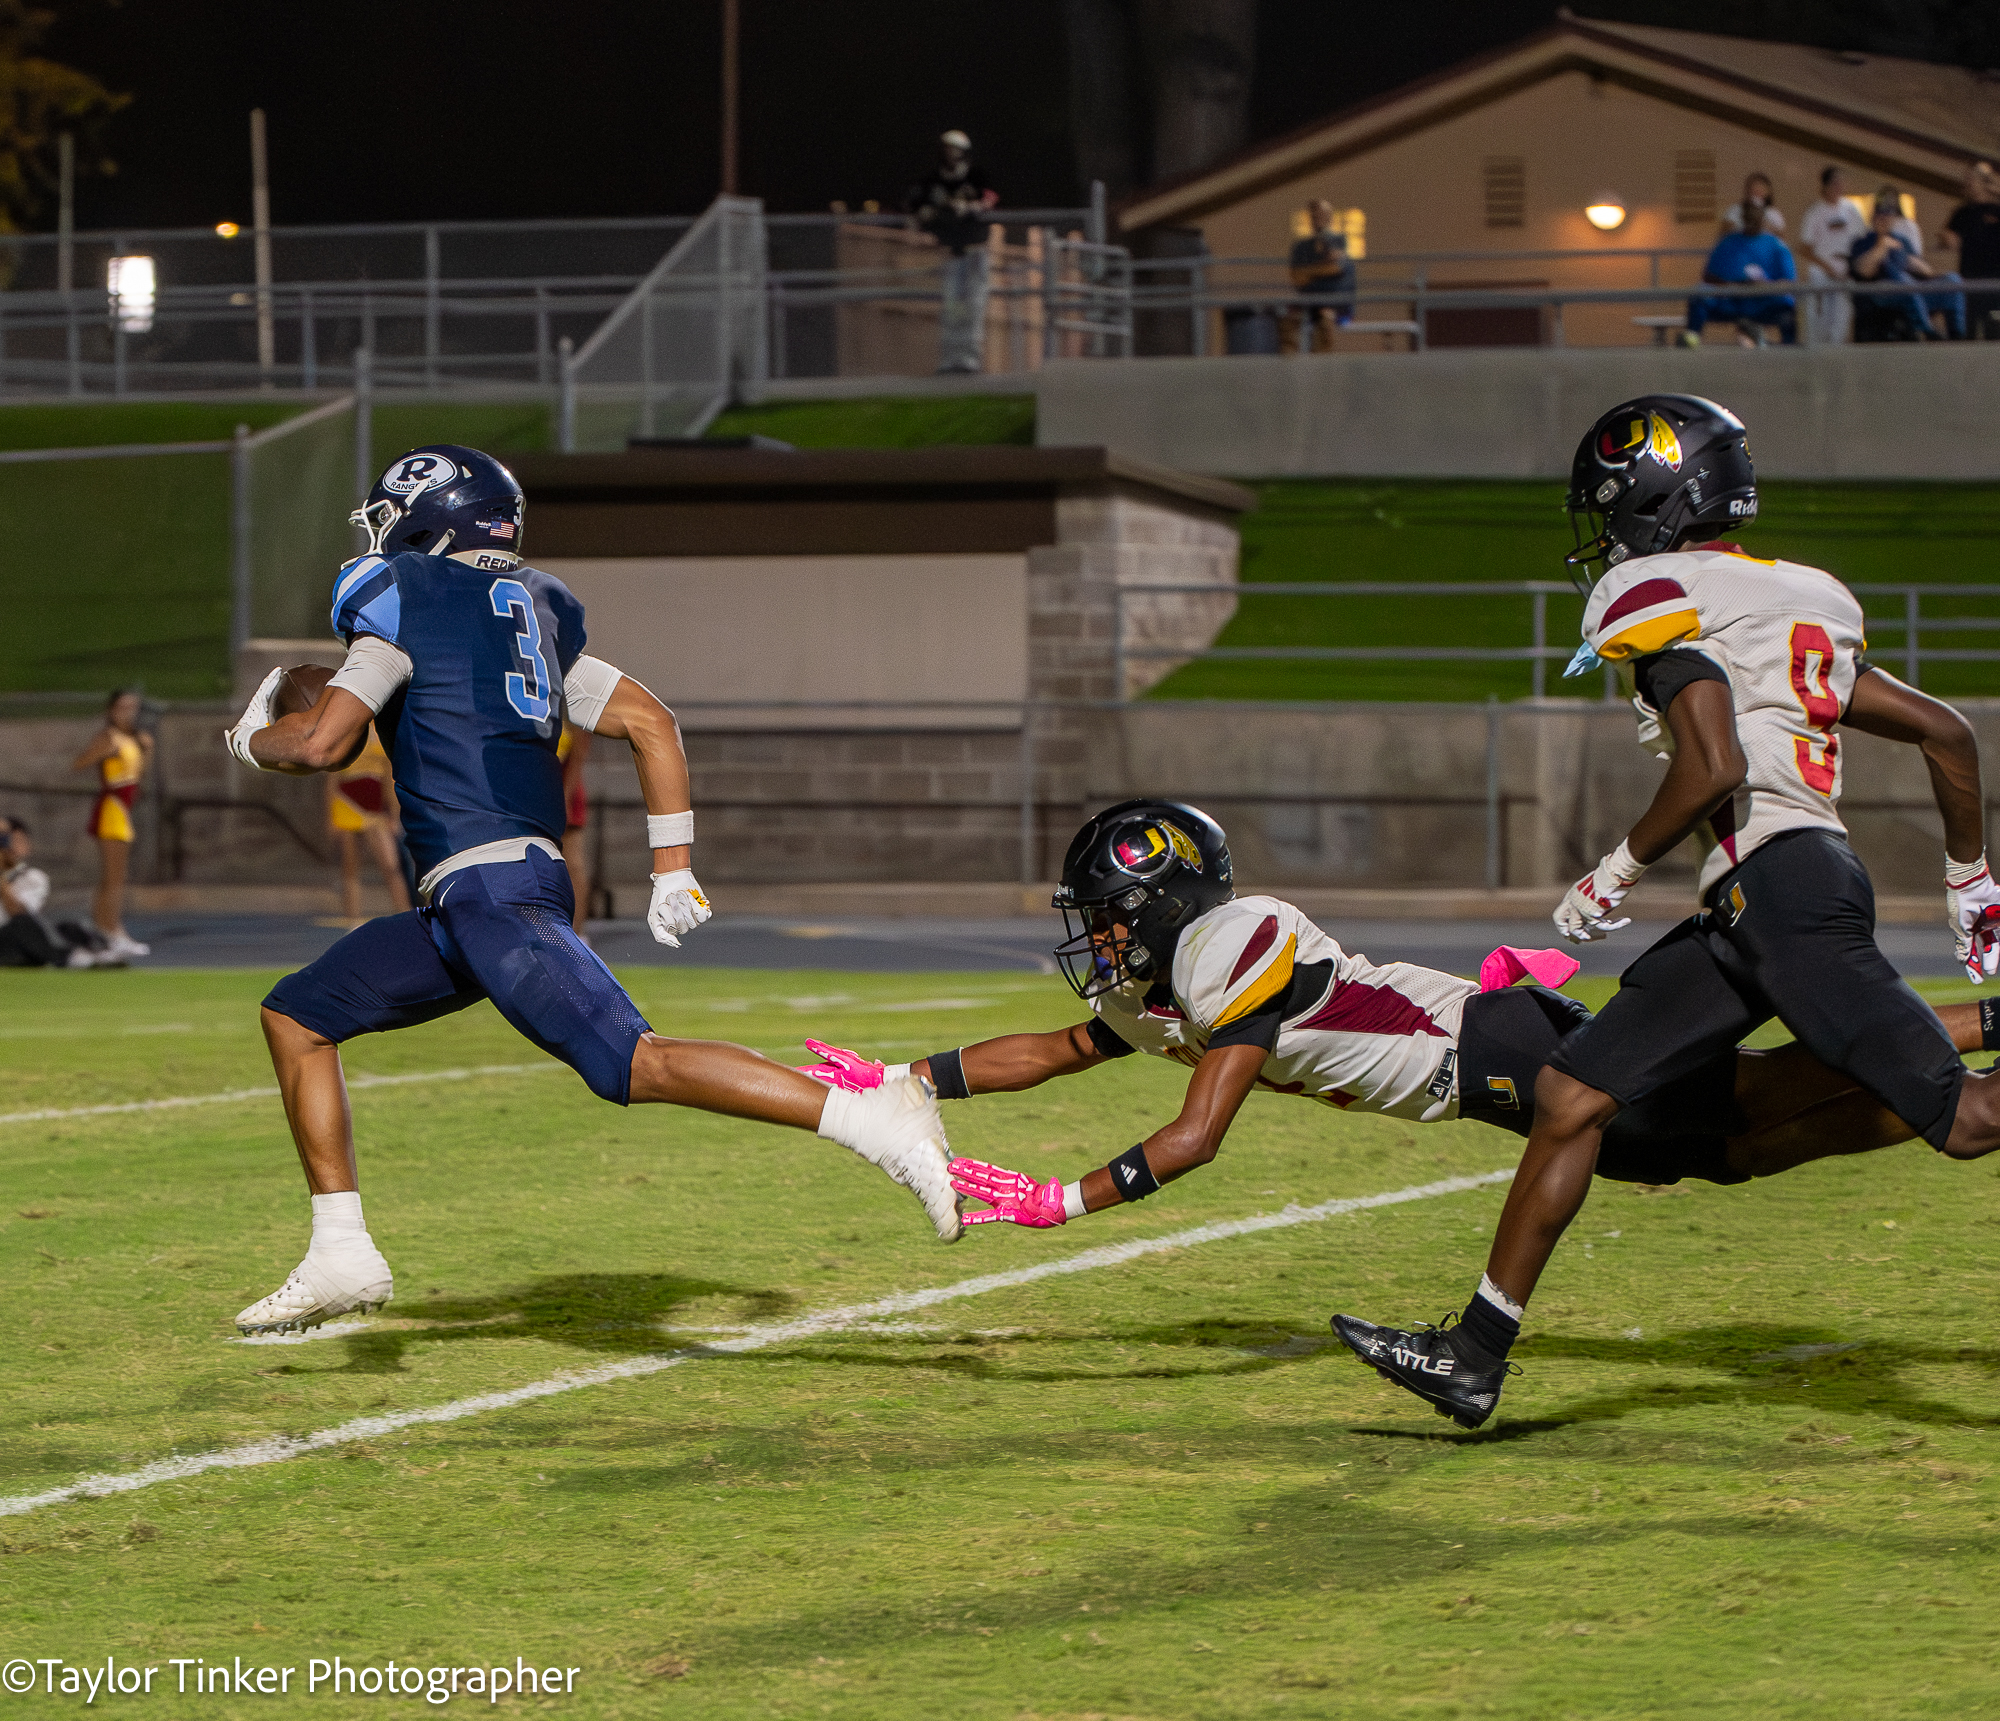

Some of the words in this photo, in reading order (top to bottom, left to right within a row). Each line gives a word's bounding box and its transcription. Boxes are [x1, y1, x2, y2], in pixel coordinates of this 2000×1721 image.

[390, 477, 438, 490] RANGS
[396, 457, 438, 482] R
[489, 577, 551, 723] 3
[1789, 622, 1840, 797] 9
